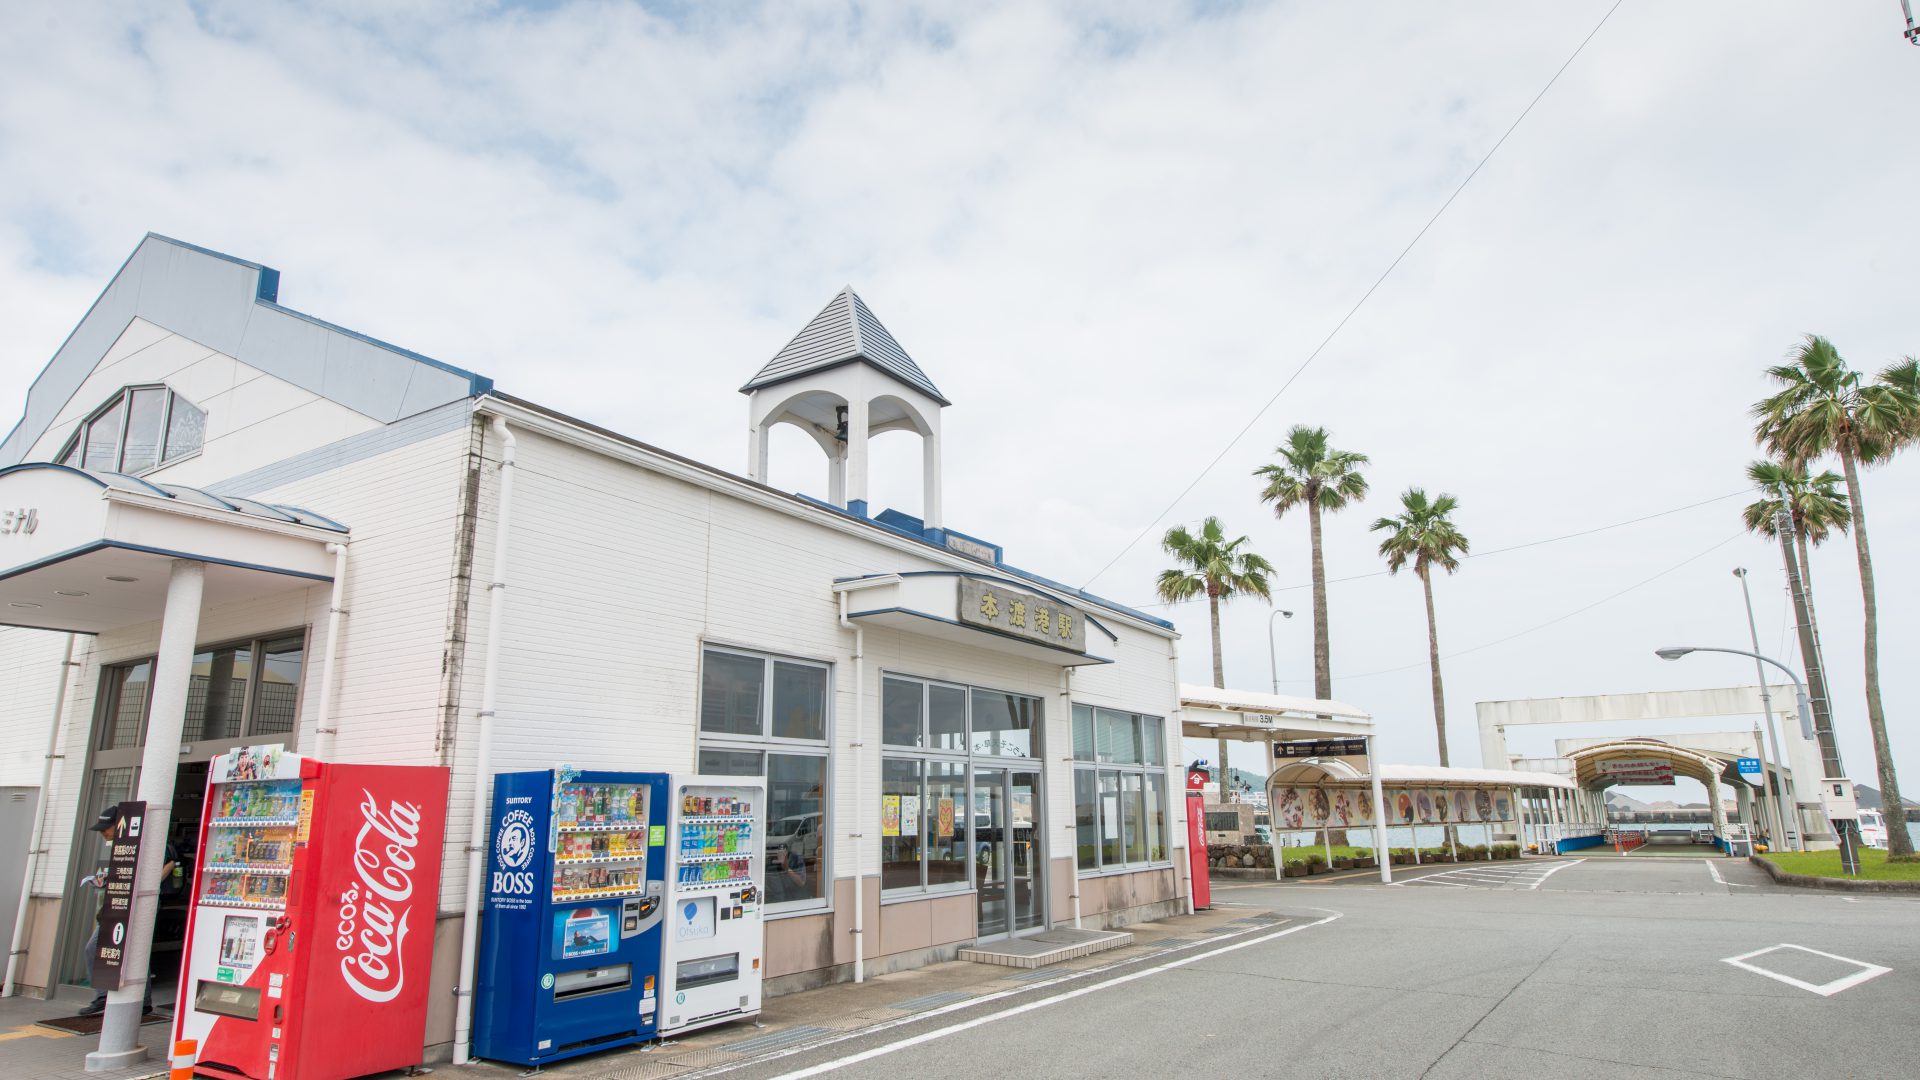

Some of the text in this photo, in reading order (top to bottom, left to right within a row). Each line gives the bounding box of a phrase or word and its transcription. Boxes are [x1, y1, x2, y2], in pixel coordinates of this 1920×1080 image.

[980, 591, 1073, 640] 本渡港駅
[506, 797, 532, 805] SUNTORY
[502, 809, 534, 828] COFFEE
[492, 871, 534, 895] BOSS
[340, 787, 421, 1003] Coca-Cola
[679, 926, 709, 938] Otsuka
